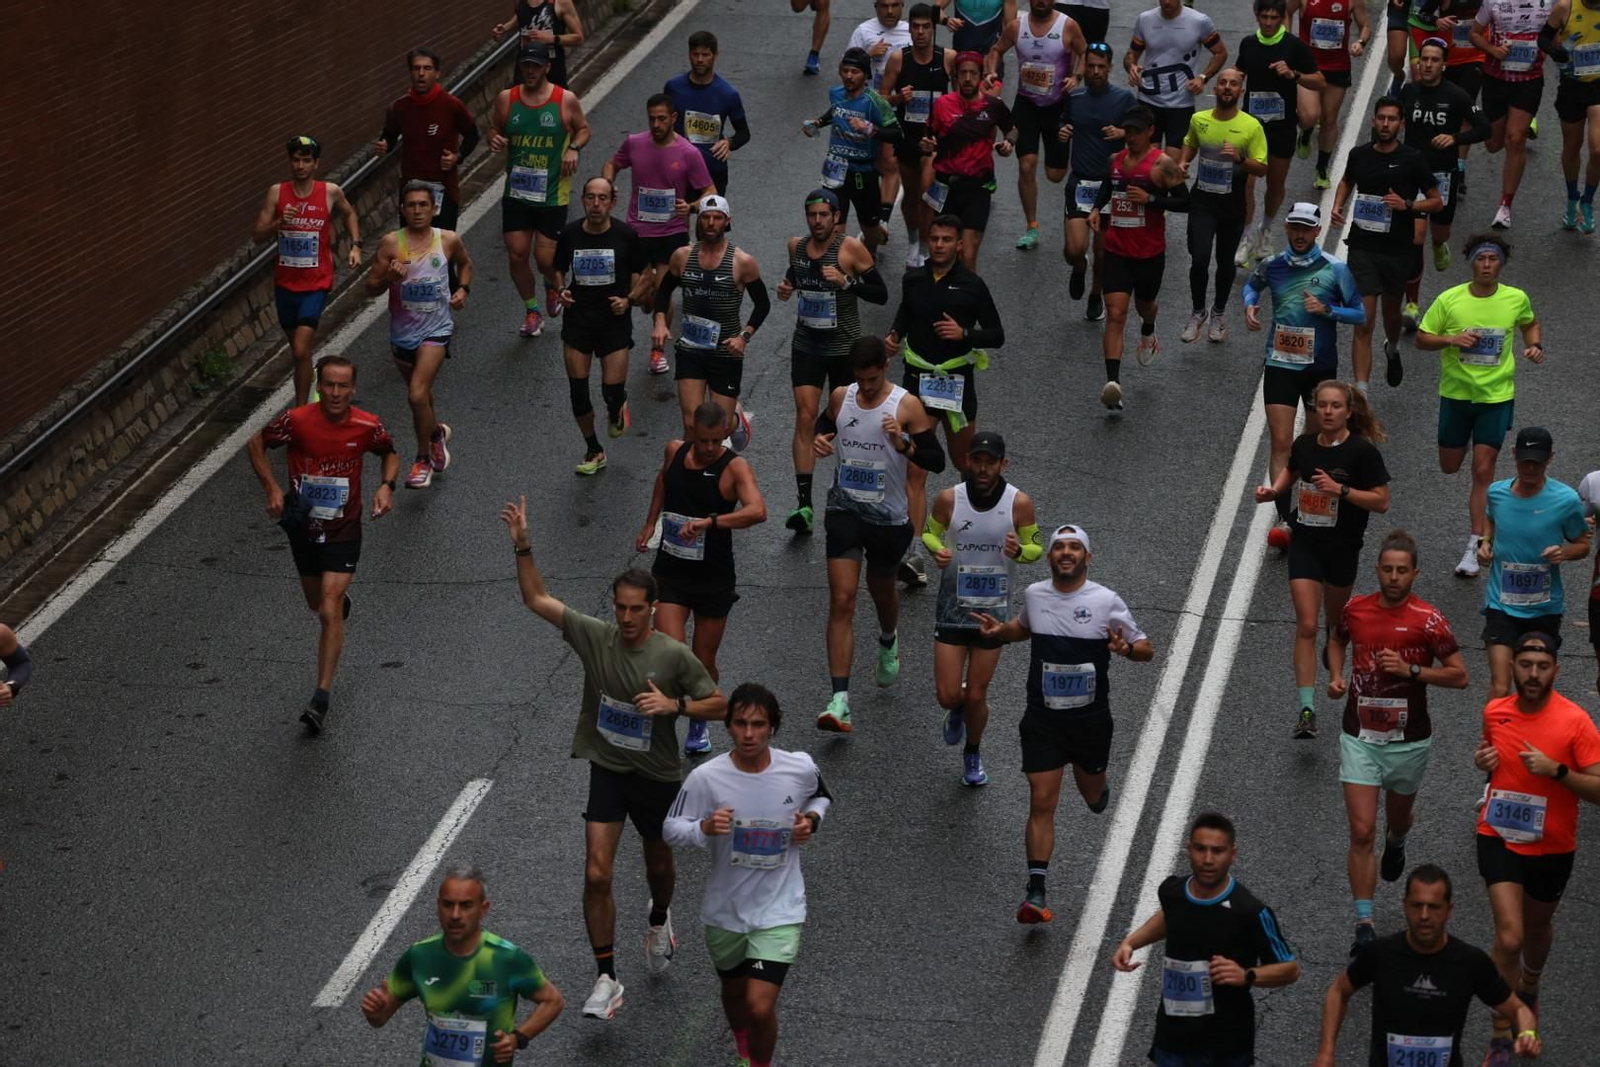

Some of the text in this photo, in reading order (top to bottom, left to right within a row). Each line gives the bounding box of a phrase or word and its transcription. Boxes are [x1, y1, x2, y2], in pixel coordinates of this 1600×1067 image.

[1412, 109, 1447, 125] PAS
[687, 119, 715, 132] 14605
[644, 195, 666, 208] 1523
[1116, 200, 1133, 212] 252
[285, 240, 309, 252] 1654
[579, 258, 605, 270] 2705
[408, 285, 433, 298] 1732
[926, 379, 954, 394] 2283
[841, 438, 885, 452] CAPACITY
[845, 468, 874, 485] 2808
[307, 486, 337, 501] 2823
[956, 543, 1003, 553] CAPACITY
[965, 576, 996, 590] 2879
[1508, 574, 1538, 587] 1897
[1050, 676, 1083, 690] 1977
[606, 710, 639, 730] 2686
[1494, 803, 1531, 823] 3146
[742, 831, 776, 847] 1777
[1396, 1049, 1437, 1067] 2180
